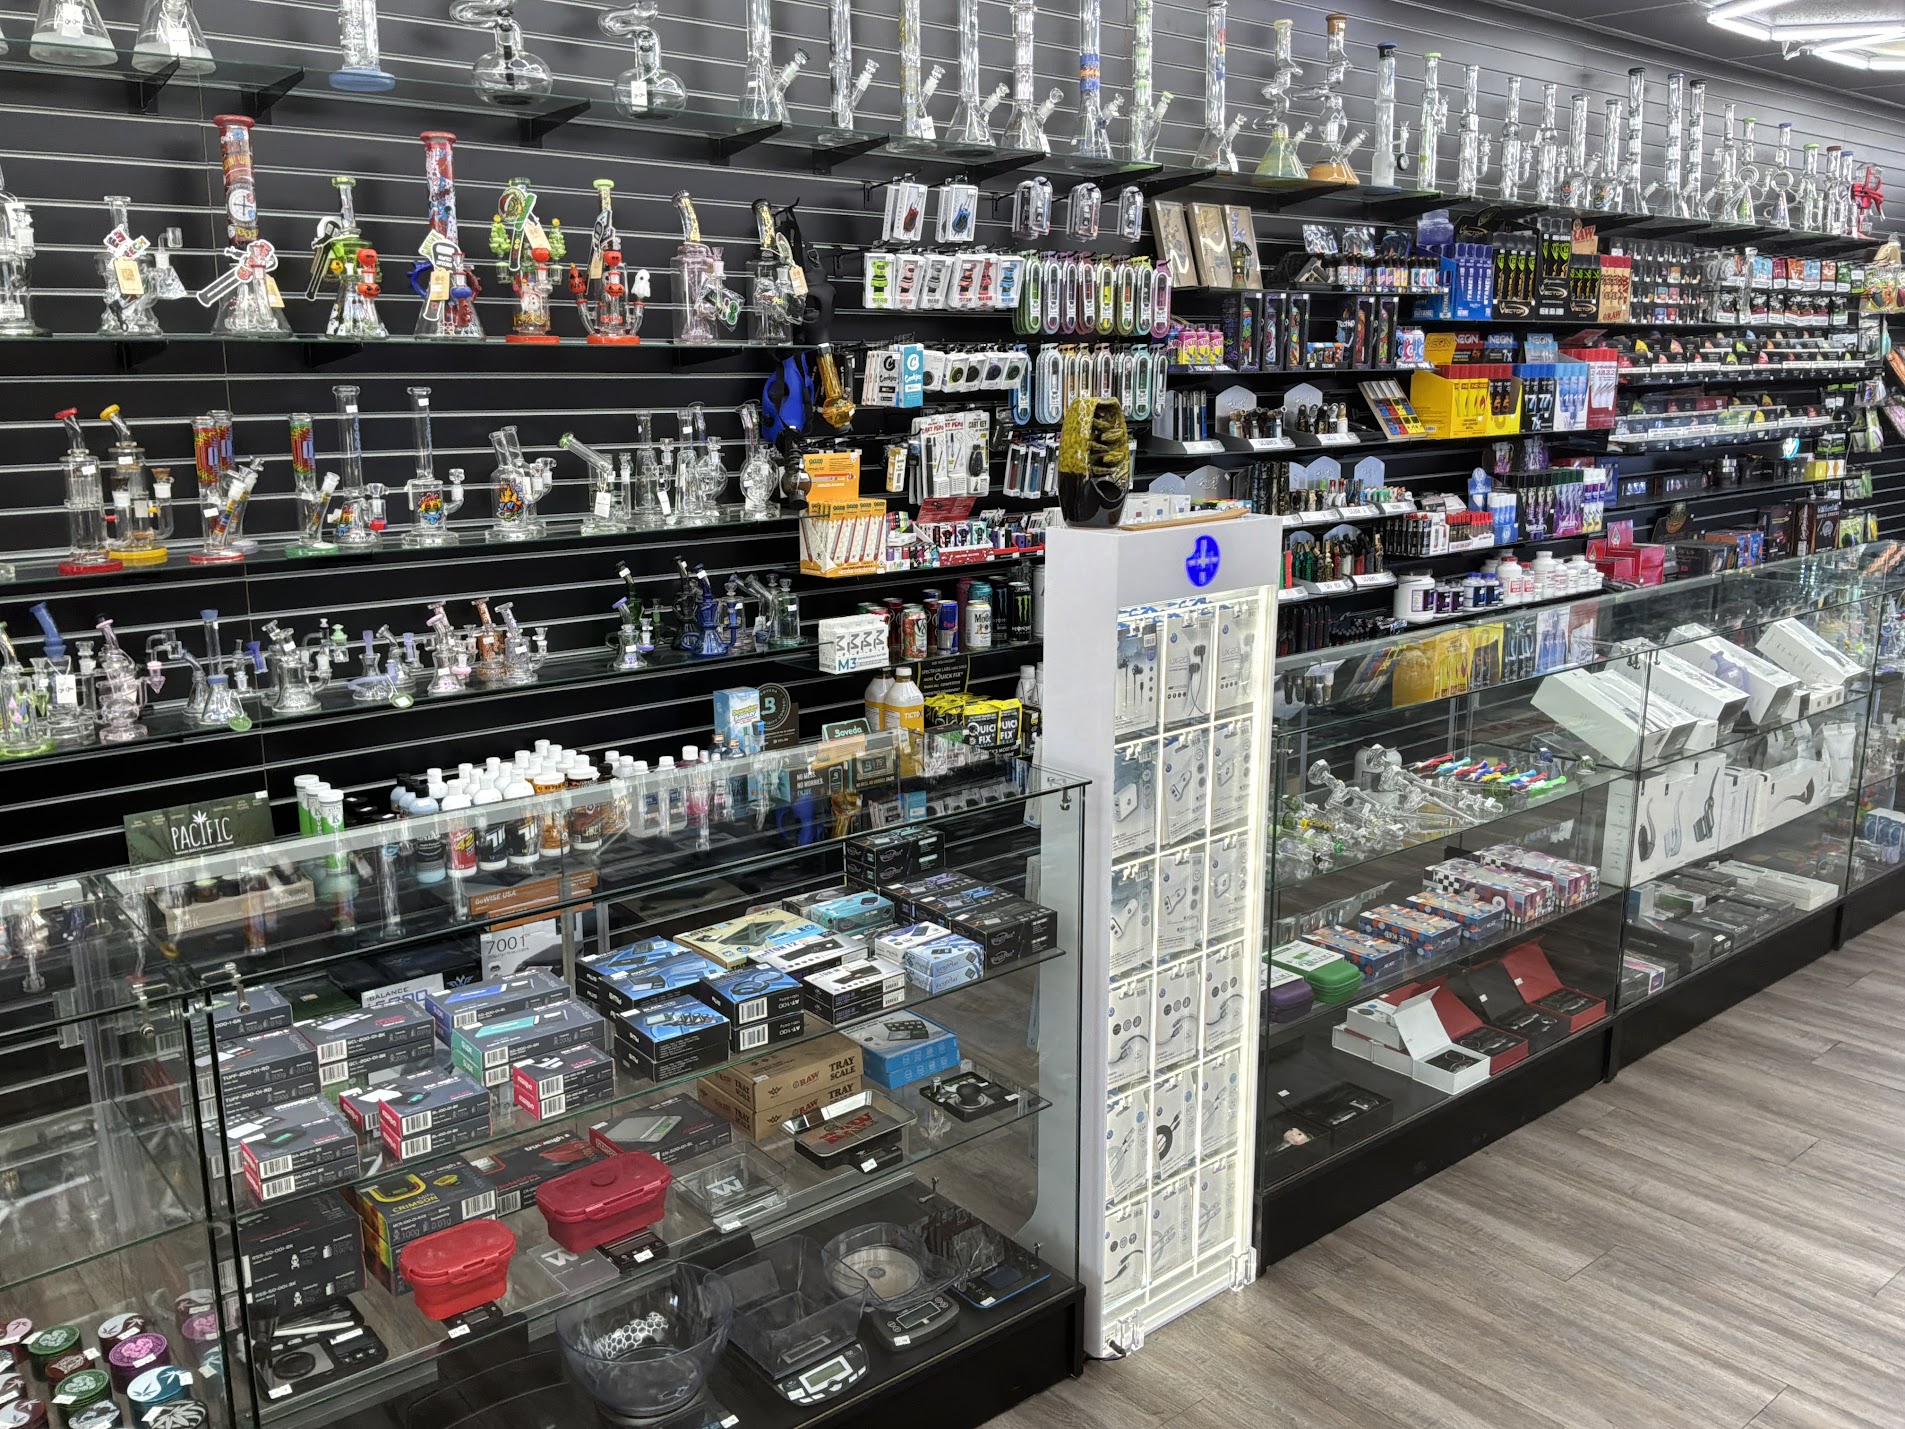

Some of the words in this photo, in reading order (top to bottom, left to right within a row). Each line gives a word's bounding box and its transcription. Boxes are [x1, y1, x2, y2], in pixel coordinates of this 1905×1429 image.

[1499, 304, 1526, 314] VECTOR
[1489, 335, 1513, 344] NEON
[905, 374, 921, 382] Cookies
[968, 421, 979, 429] CART
[979, 420, 987, 428] KEY
[838, 657, 857, 672] M3
[835, 725, 863, 738] Boveda
[979, 734, 992, 744] FIX
[1000, 731, 1013, 740] FIX
[171, 814, 234, 851] PACIFIC
[474, 893, 501, 905] GoWISE
[502, 890, 517, 899] USA
[486, 936, 526, 955] 7001
[778, 999, 800, 1009] AT-100
[779, 1025, 801, 1035] AT-100
[828, 1056, 855, 1072] TRAY
[222, 1065, 270, 1081] TUFF-200-01-RD
[799, 1071, 820, 1087] RAW
[829, 1066, 856, 1081] SCALE
[735, 1079, 750, 1094] TRAY
[828, 1083, 854, 1099] TRAY
[225, 1087, 273, 1103] TUFF-200-01-RD
[735, 1107, 750, 1122] TRAY
[799, 1099, 819, 1115] RAW
[392, 1195, 439, 1213] CRIMSON
[431, 1218, 452, 1230] 0.01g
[401, 1229, 420, 1239] 100g
